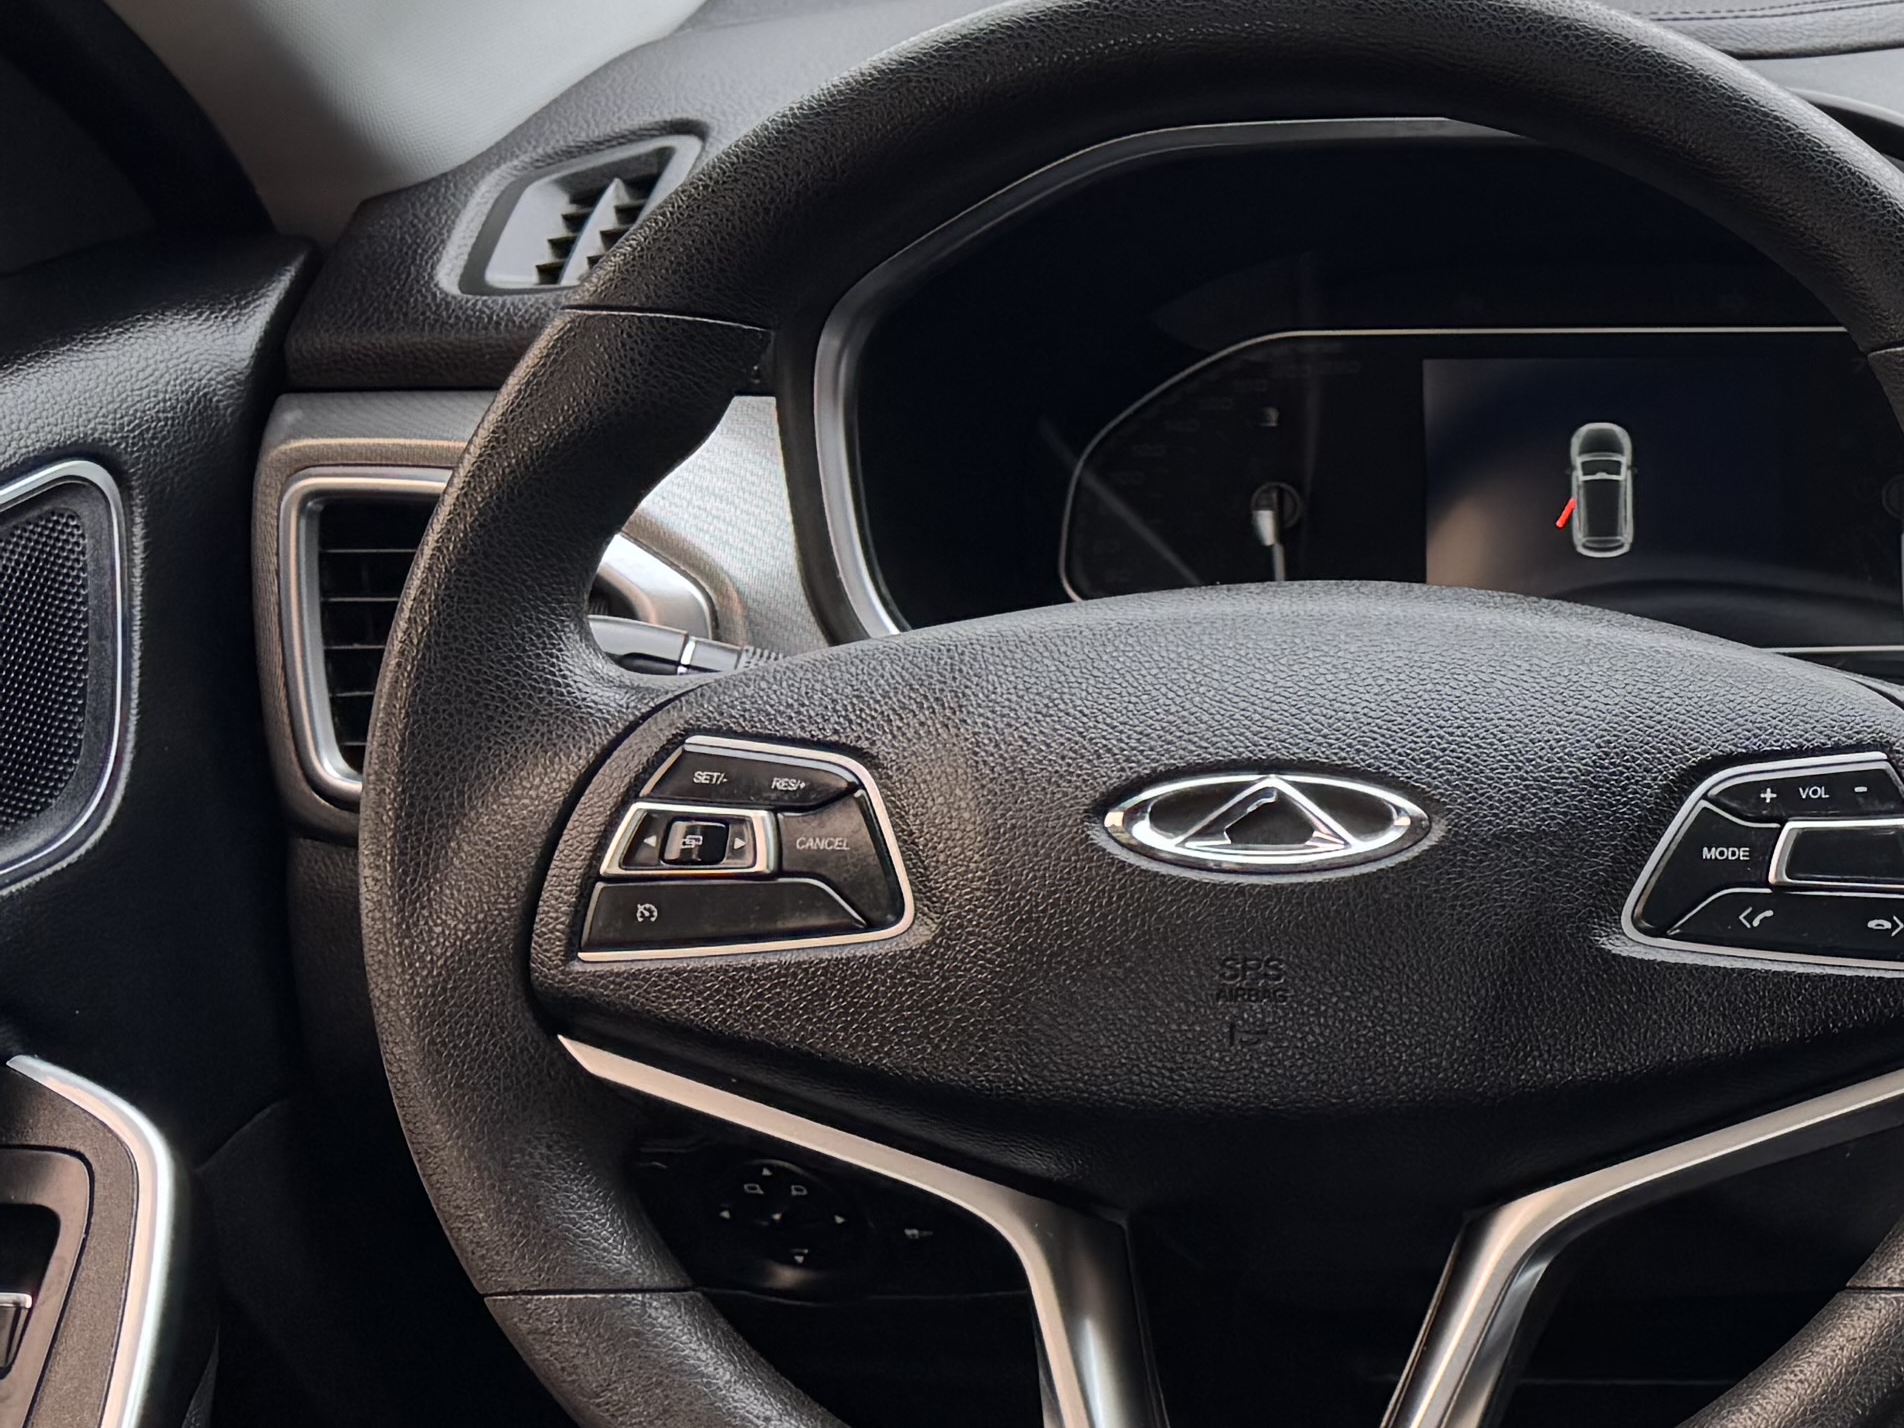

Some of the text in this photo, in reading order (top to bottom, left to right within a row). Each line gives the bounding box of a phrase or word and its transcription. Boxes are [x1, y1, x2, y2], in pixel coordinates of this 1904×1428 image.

[1799, 785, 1830, 799] VOL
[796, 836, 850, 851] CANCEL
[1702, 846, 1750, 860] MODE
[1214, 987, 1291, 1004] AIRBAG
